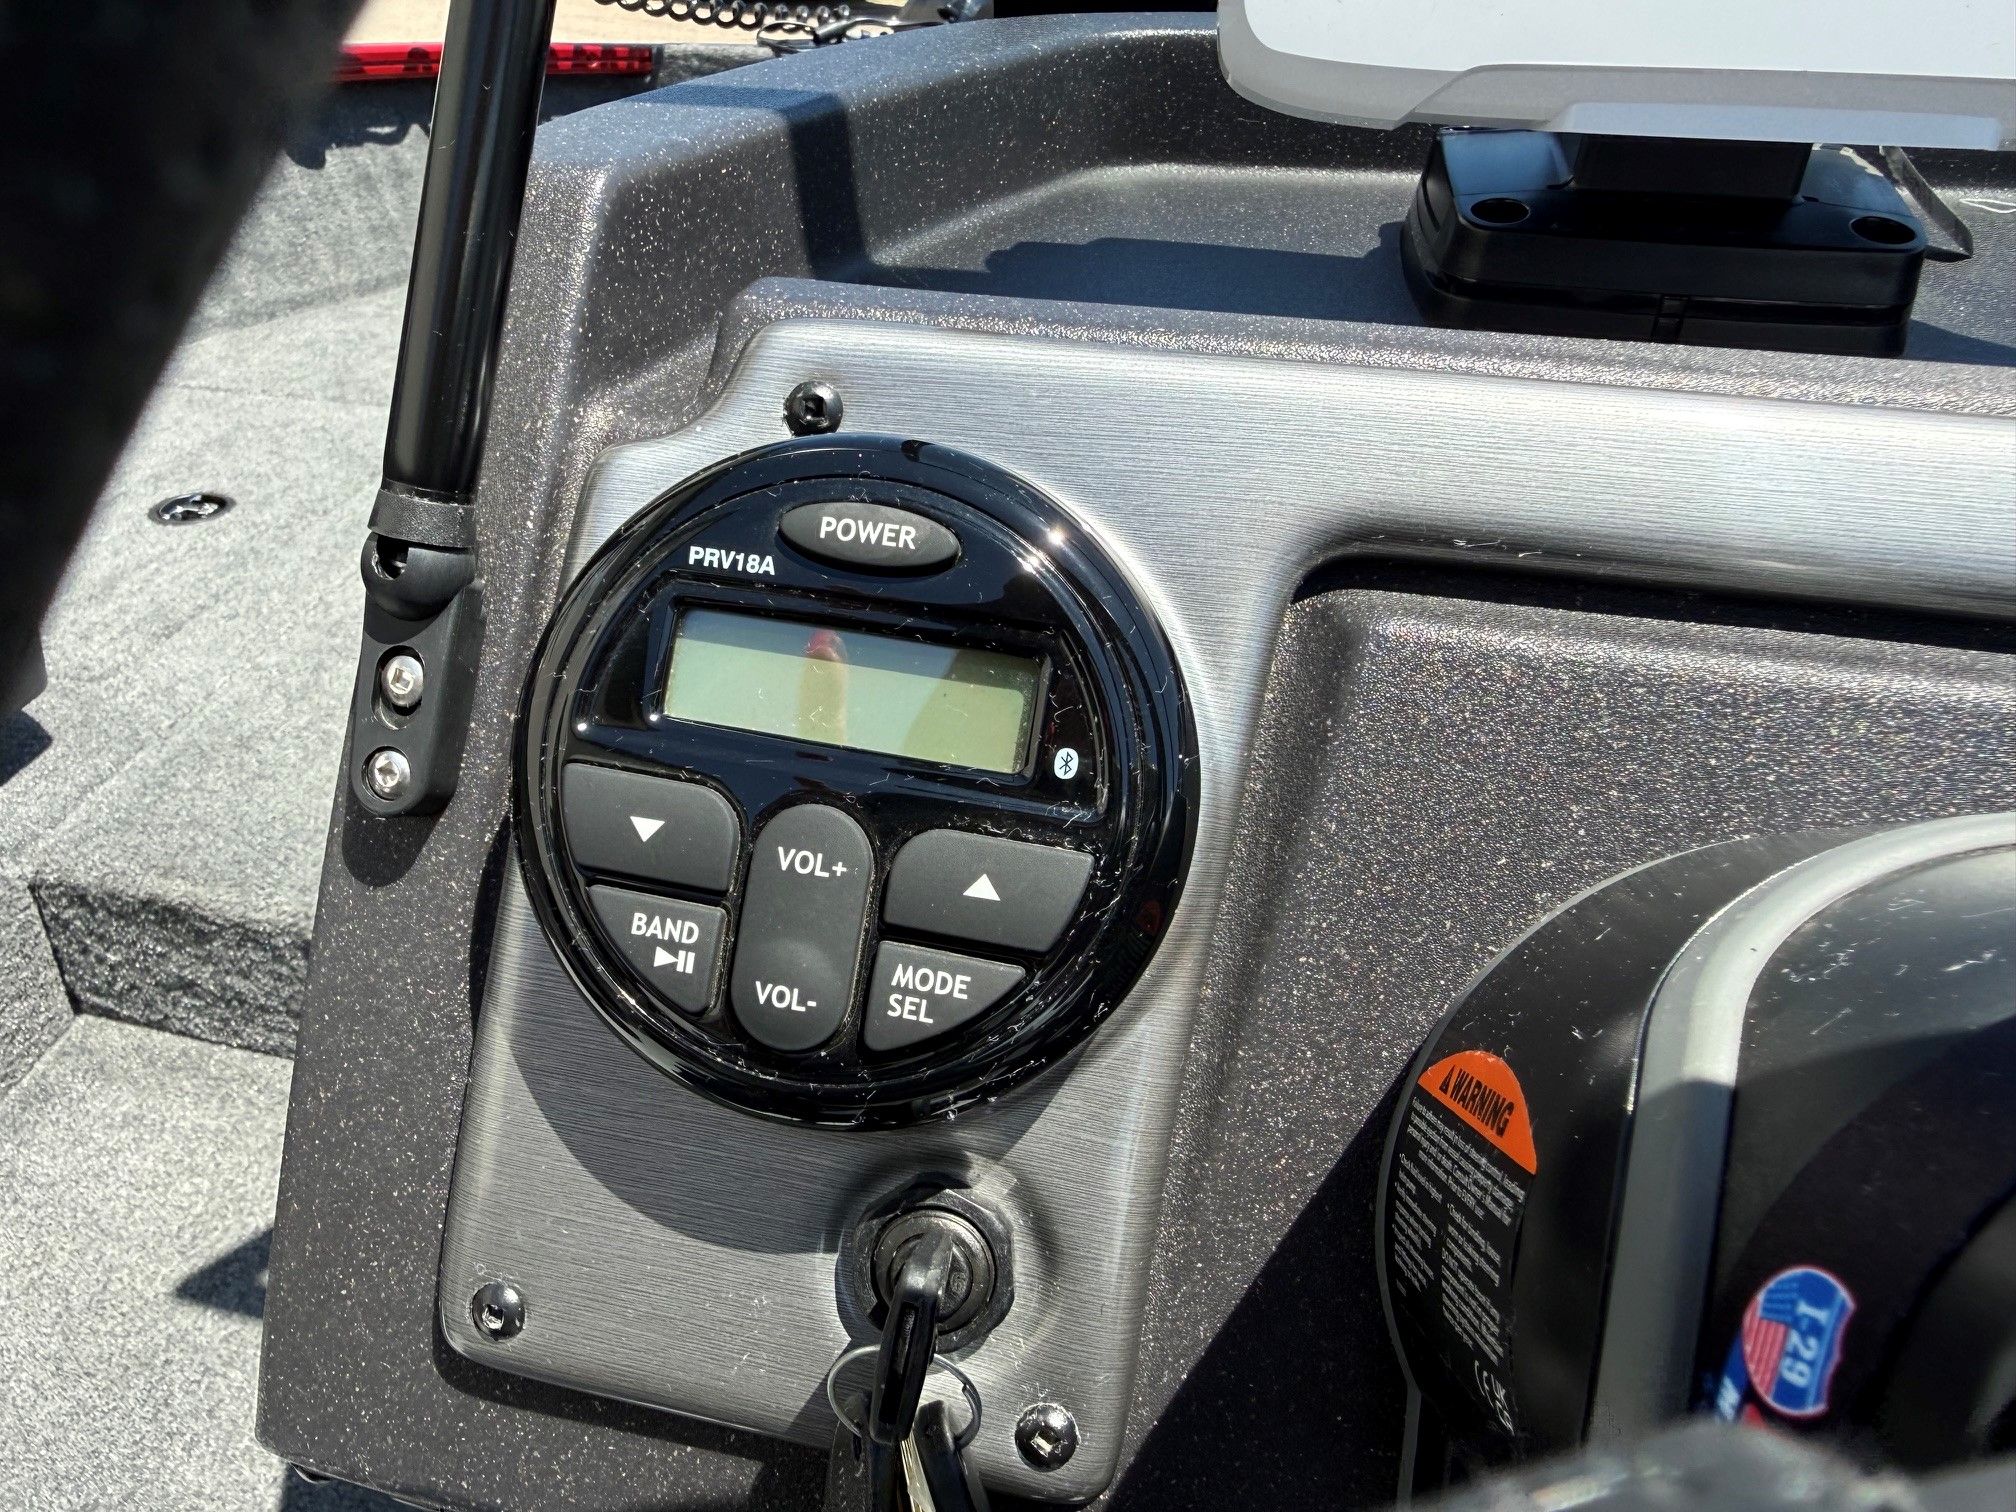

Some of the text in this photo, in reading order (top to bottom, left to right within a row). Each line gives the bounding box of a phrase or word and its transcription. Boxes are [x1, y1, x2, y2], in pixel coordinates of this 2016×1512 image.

[818, 515, 917, 552] POWER
[688, 545, 776, 576] PRV18A
[777, 845, 848, 879] VOL+
[630, 911, 700, 945] BAND
[755, 980, 818, 1013] VOL-
[890, 960, 972, 1001] MODE
[886, 992, 934, 1025] SEL
[1450, 1068, 1515, 1138] WARNING
